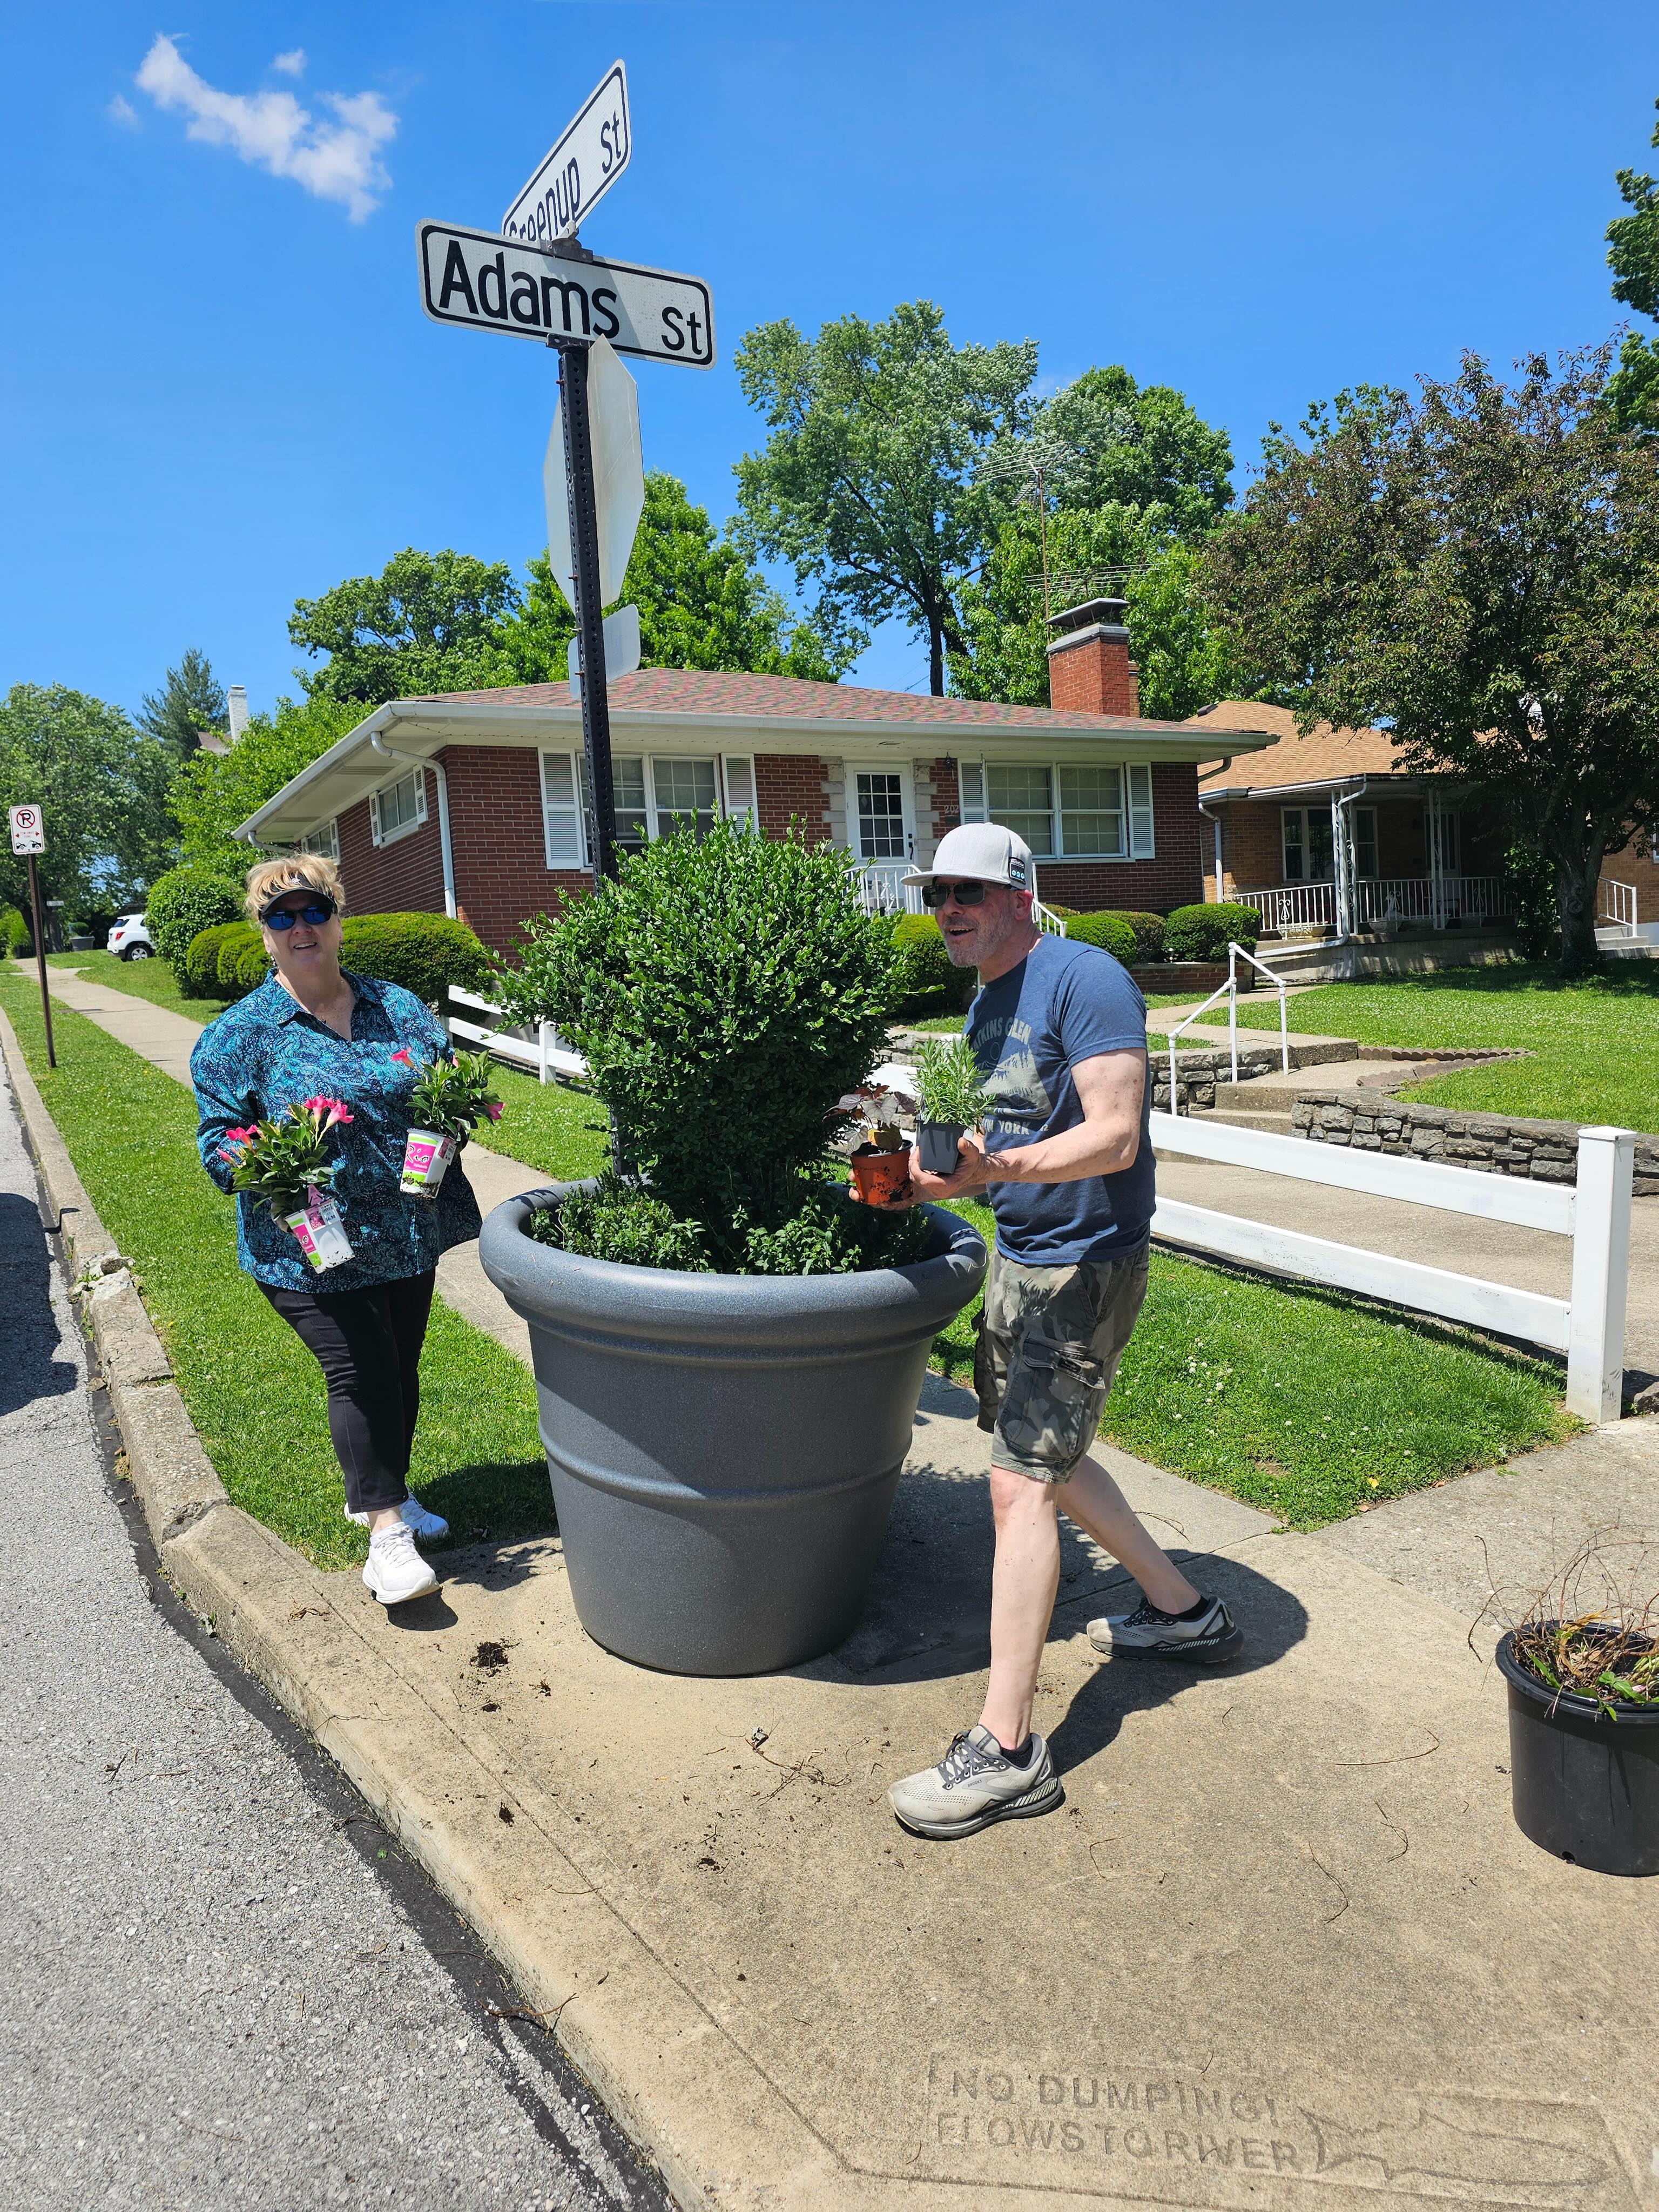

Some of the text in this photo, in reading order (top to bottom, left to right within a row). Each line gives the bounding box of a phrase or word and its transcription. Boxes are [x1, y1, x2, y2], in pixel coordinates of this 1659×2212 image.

[601, 110, 622, 174] St
[439, 239, 703, 355] Adams St
[1004, 1017, 1032, 1045] GLEN
[998, 1120, 1031, 1135] YORK
[952, 2071, 1015, 2102] NO
